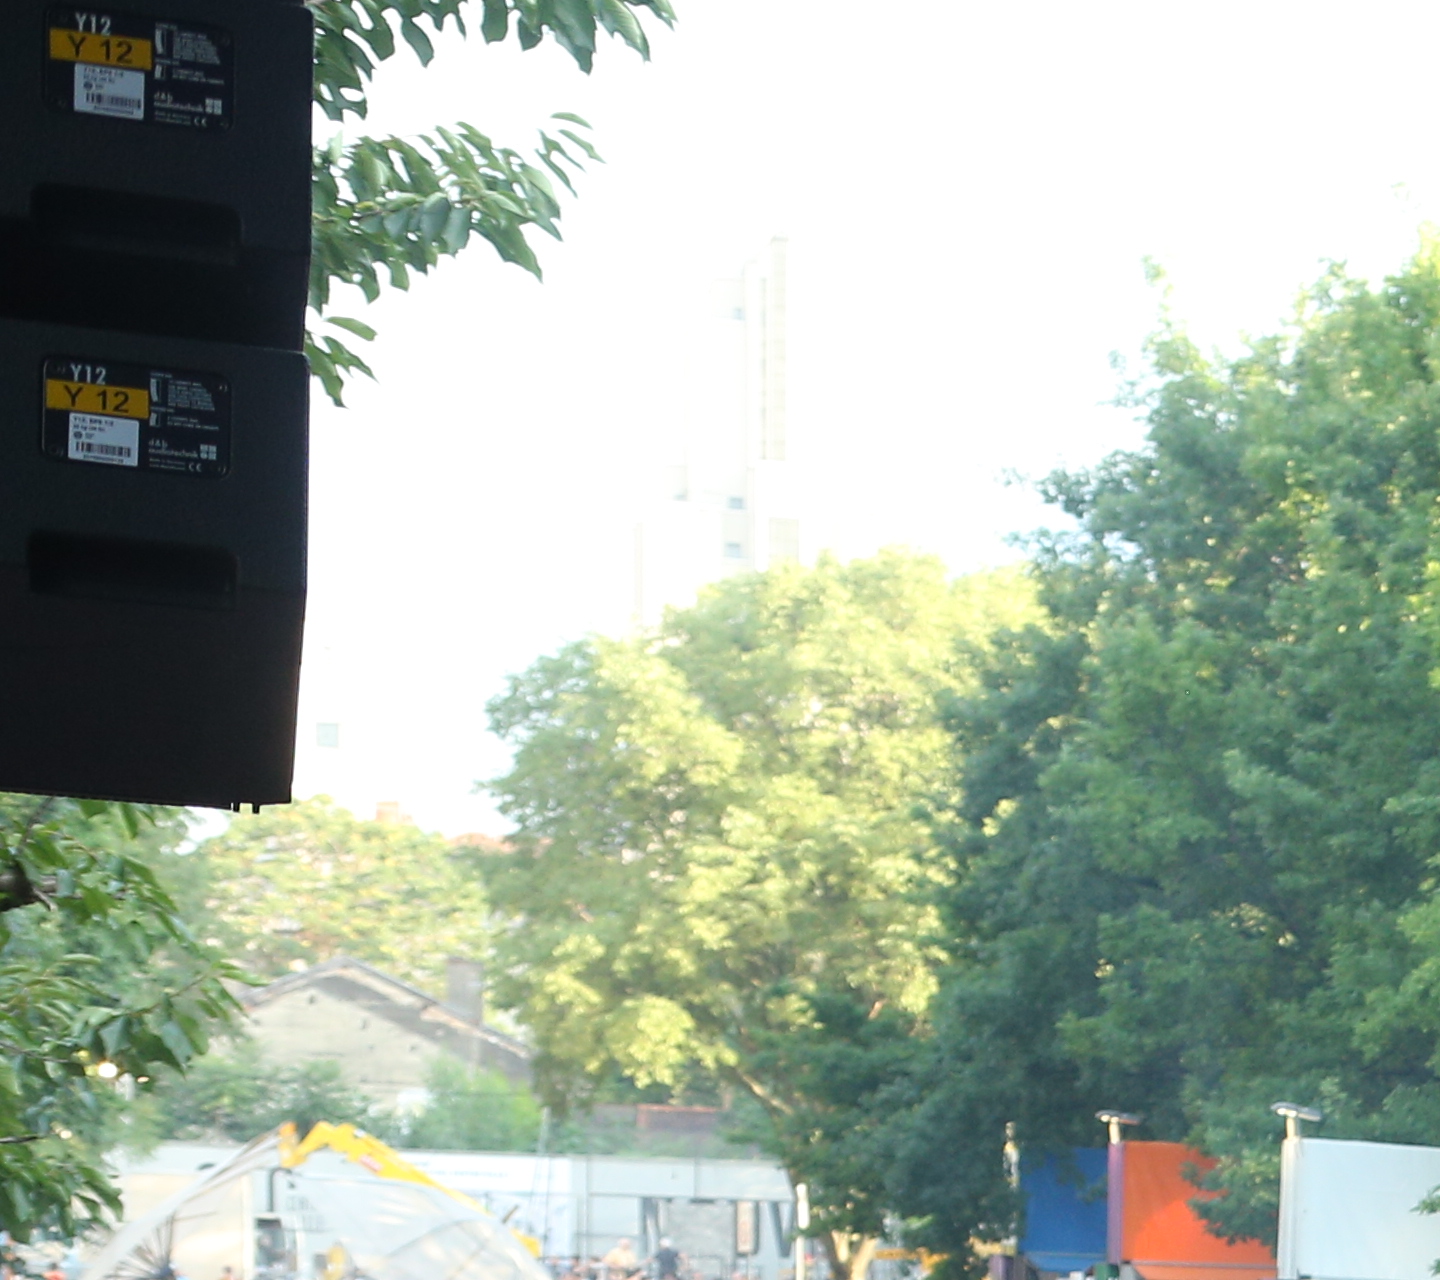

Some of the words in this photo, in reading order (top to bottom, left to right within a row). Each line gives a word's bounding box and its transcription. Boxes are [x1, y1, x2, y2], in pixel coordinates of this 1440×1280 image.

[75, 12, 112, 36] Y12
[67, 33, 86, 58] Y
[100, 39, 133, 63] 12
[69, 363, 107, 385] Y12
[63, 385, 83, 407] Y
[97, 389, 129, 413] 12
